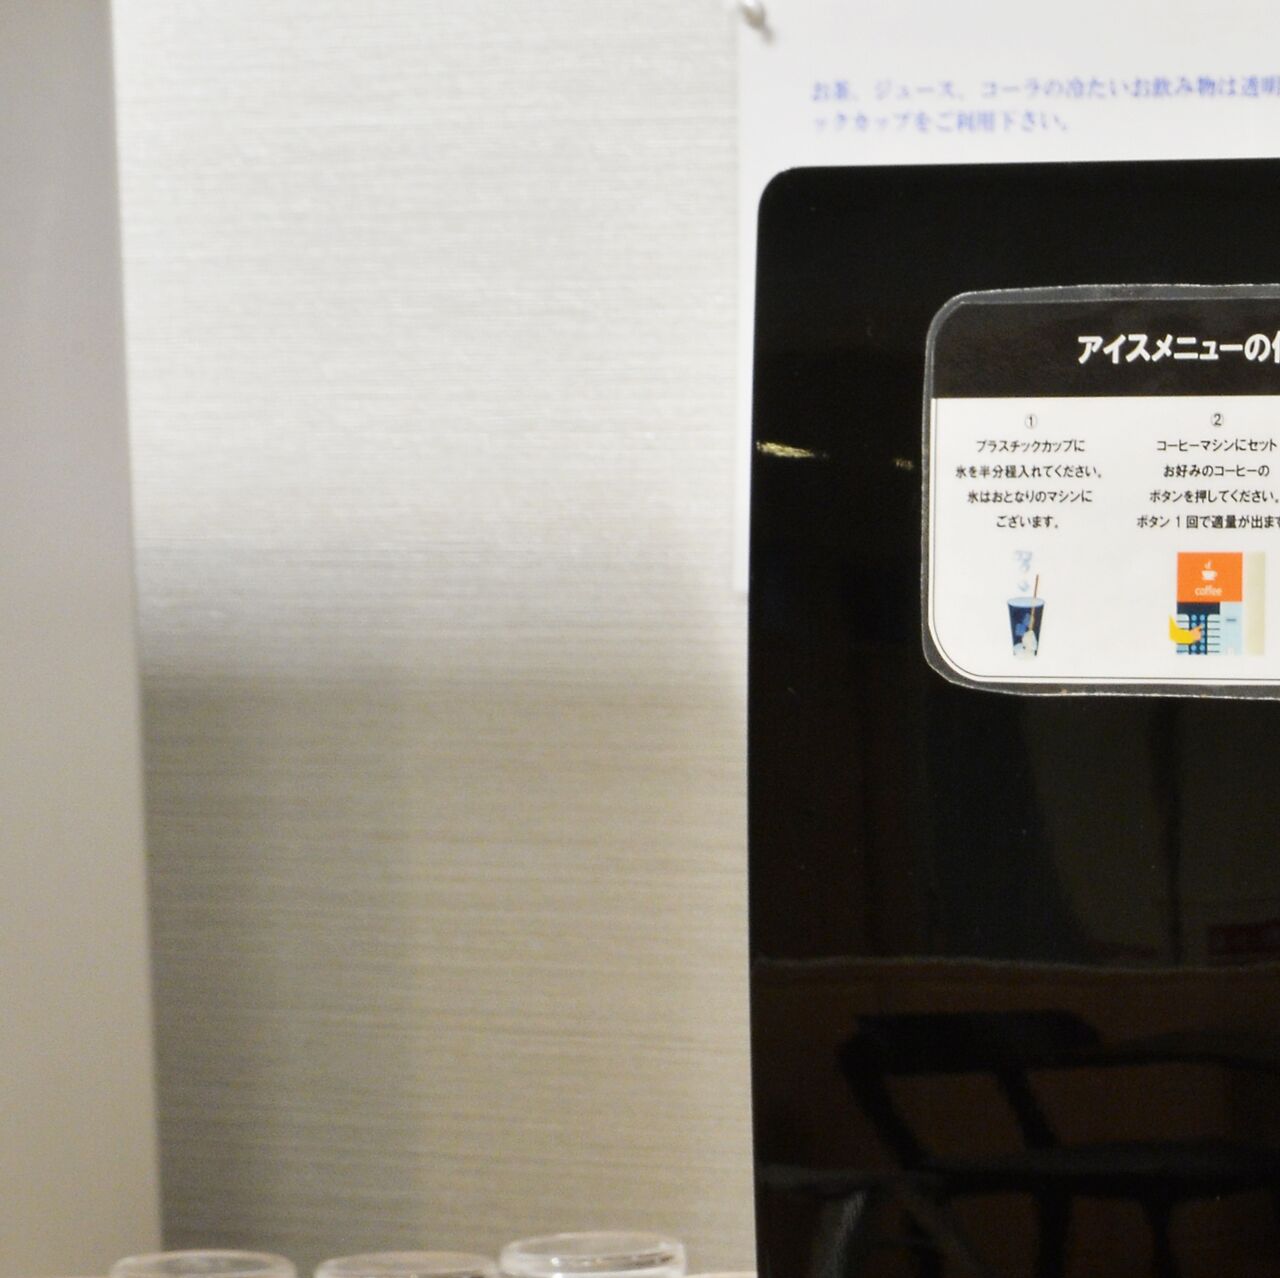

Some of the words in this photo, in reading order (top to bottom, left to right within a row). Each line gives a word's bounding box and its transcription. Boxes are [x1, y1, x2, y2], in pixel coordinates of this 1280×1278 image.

[976, 439, 1085, 453] プラスチックカップに
[1156, 438, 1278, 453] コーヒーマシンにセット
[955, 464, 1102, 479] 氷を半分程入れてください。
[1163, 463, 1270, 479] お好みのコーヒーの
[967, 489, 1093, 504] 氷はおとなりのマシンに
[1149, 488, 1279, 504] ボタンを押してください。
[996, 514, 1059, 529] ございます。
